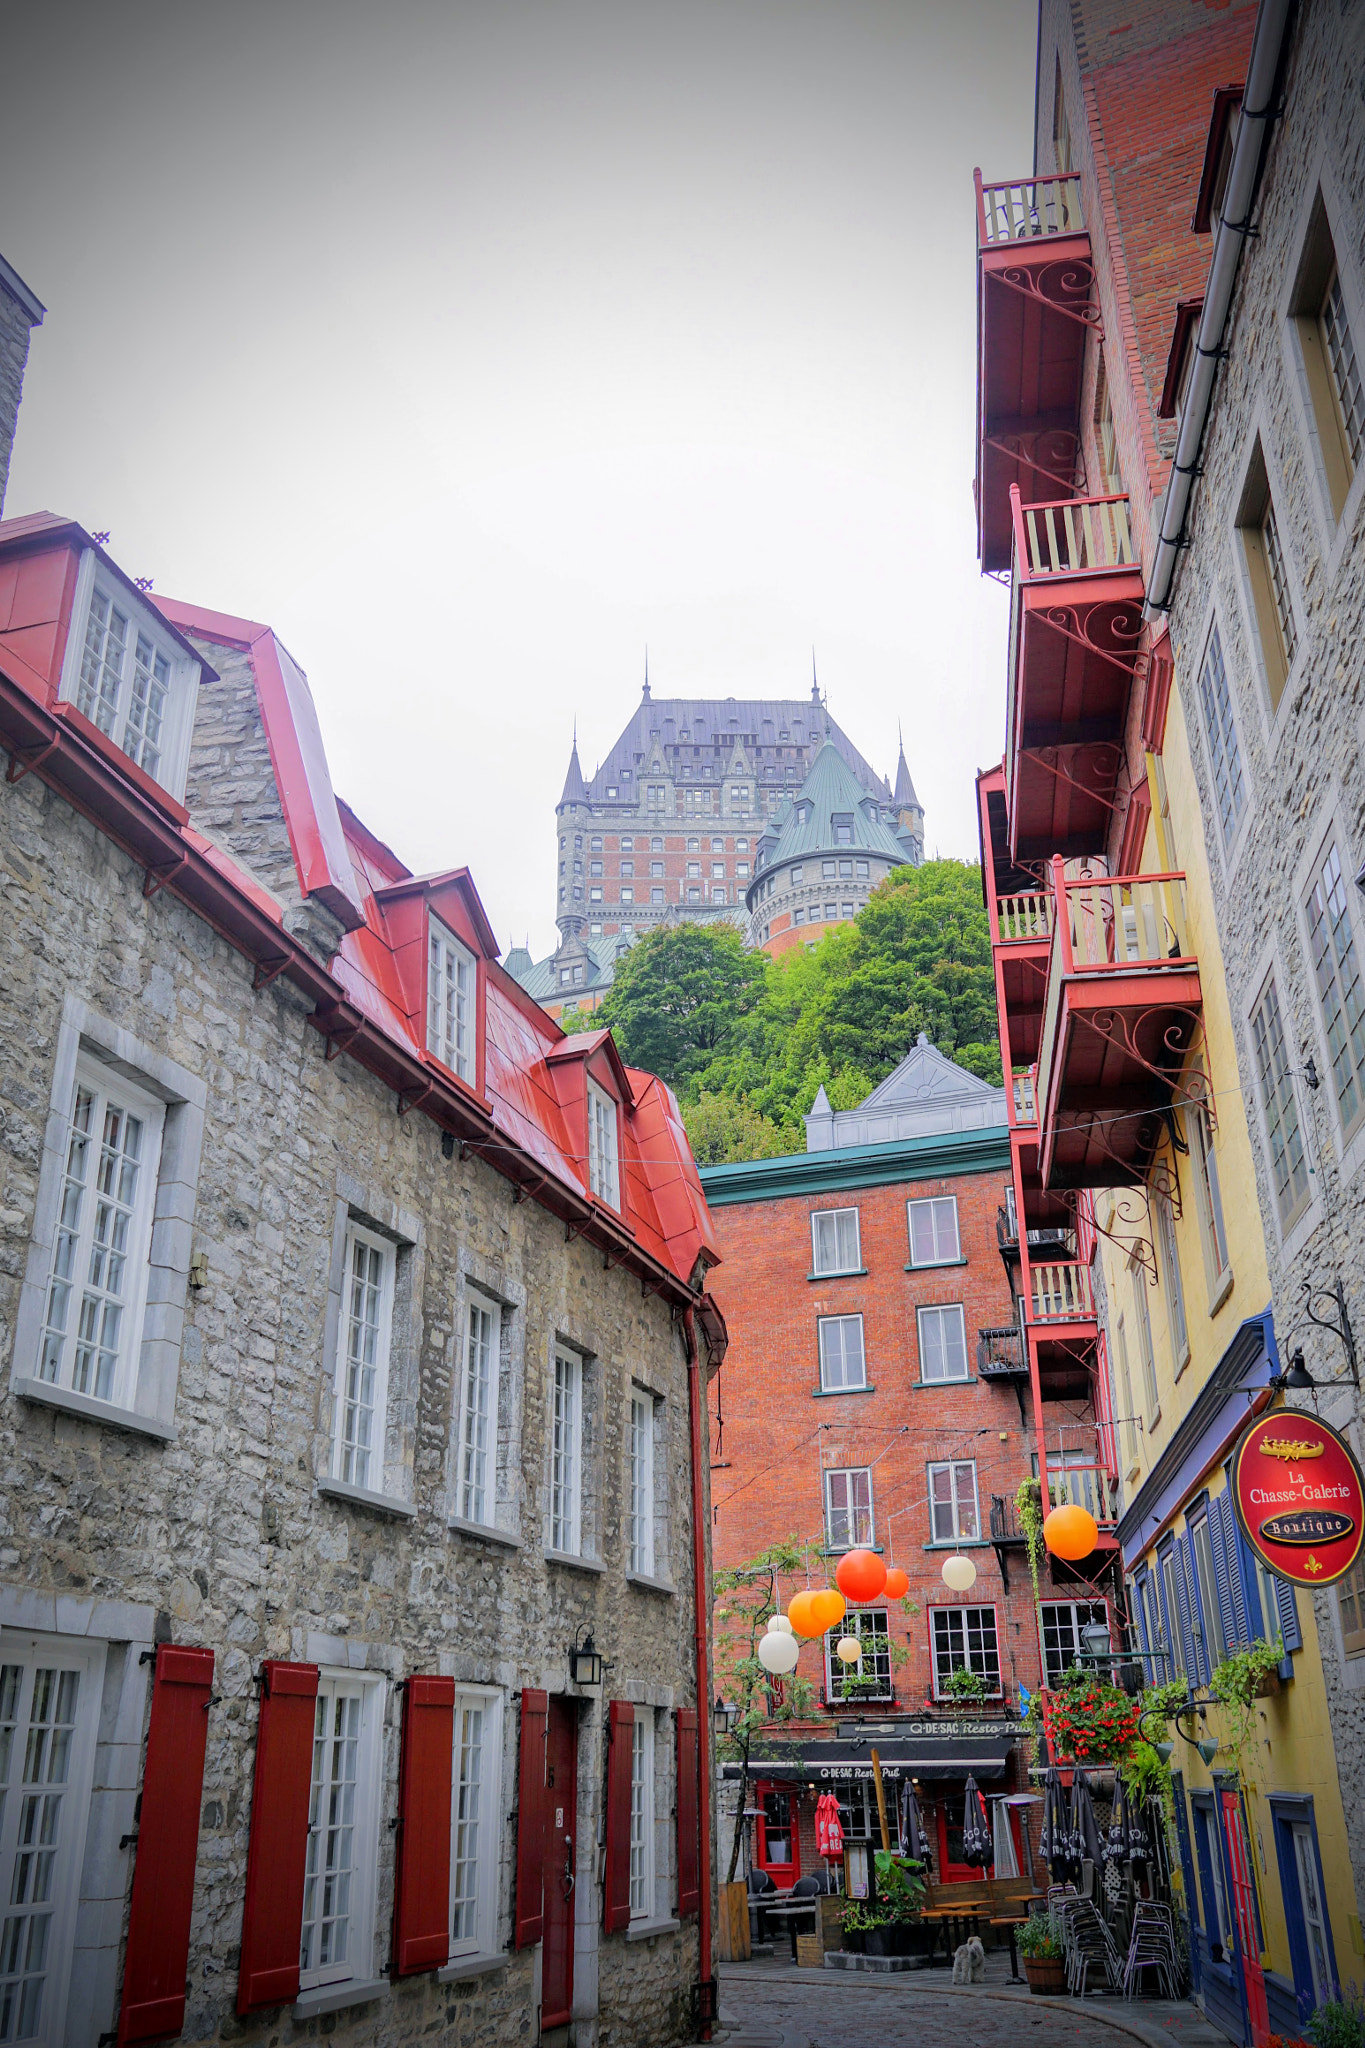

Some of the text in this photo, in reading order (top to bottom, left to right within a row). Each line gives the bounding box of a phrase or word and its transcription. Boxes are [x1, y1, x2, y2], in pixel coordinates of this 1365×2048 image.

[1288, 1471, 1305, 1484] La
[1250, 1483, 1351, 1504] Chasse-Galerie
[1272, 1520, 1342, 1534] Boutique
